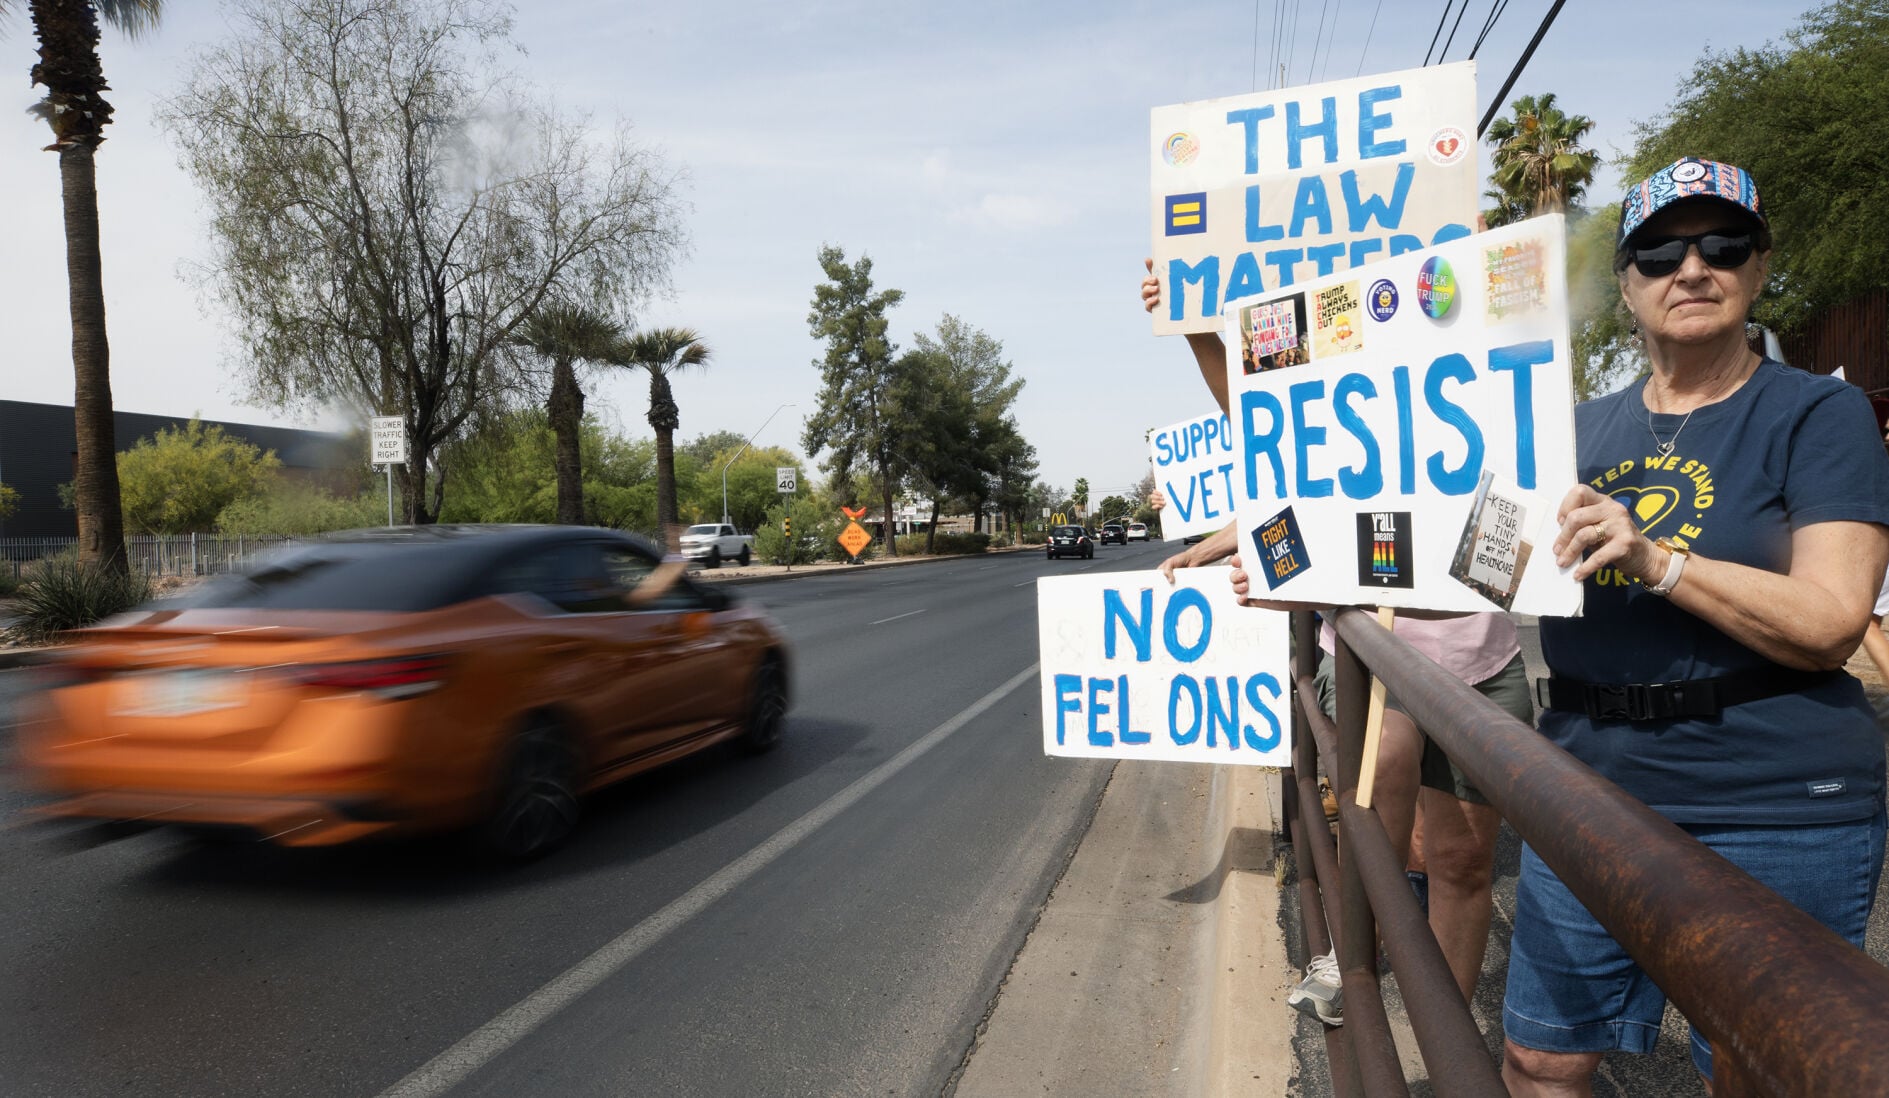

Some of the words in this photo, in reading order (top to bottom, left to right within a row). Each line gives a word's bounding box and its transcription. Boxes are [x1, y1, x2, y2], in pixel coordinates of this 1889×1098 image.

[1227, 85, 1406, 174] THE
[1245, 162, 1415, 243] LAW
[1420, 272, 1448, 287] FUCK
[1316, 285, 1345, 302] TRUMP
[1317, 293, 1349, 311] ALWAYS
[1418, 289, 1450, 303] TRUMP
[1318, 299, 1358, 321] CHICKENS
[1318, 317, 1333, 330] OUT
[374, 421, 402, 429] SLOWER
[1240, 339, 1554, 500] RESIST
[377, 450, 399, 459] RIGHT
[378, 440, 398, 449] KEEP
[779, 480, 795, 490] 40
[1645, 456, 1681, 470] WE
[1680, 460, 1714, 509] STAND
[1497, 512, 1518, 532] YOUR
[1261, 518, 1288, 549] FIGHT
[1373, 532, 1395, 542] means
[1483, 531, 1511, 551] HANDS
[1494, 524, 1515, 542] TINY
[1271, 539, 1290, 560] LIKE
[1373, 541, 1398, 573] ALL
[1273, 553, 1299, 579] HELL
[1476, 552, 1514, 576] HEALTHCARE
[1103, 587, 1212, 663] NO
